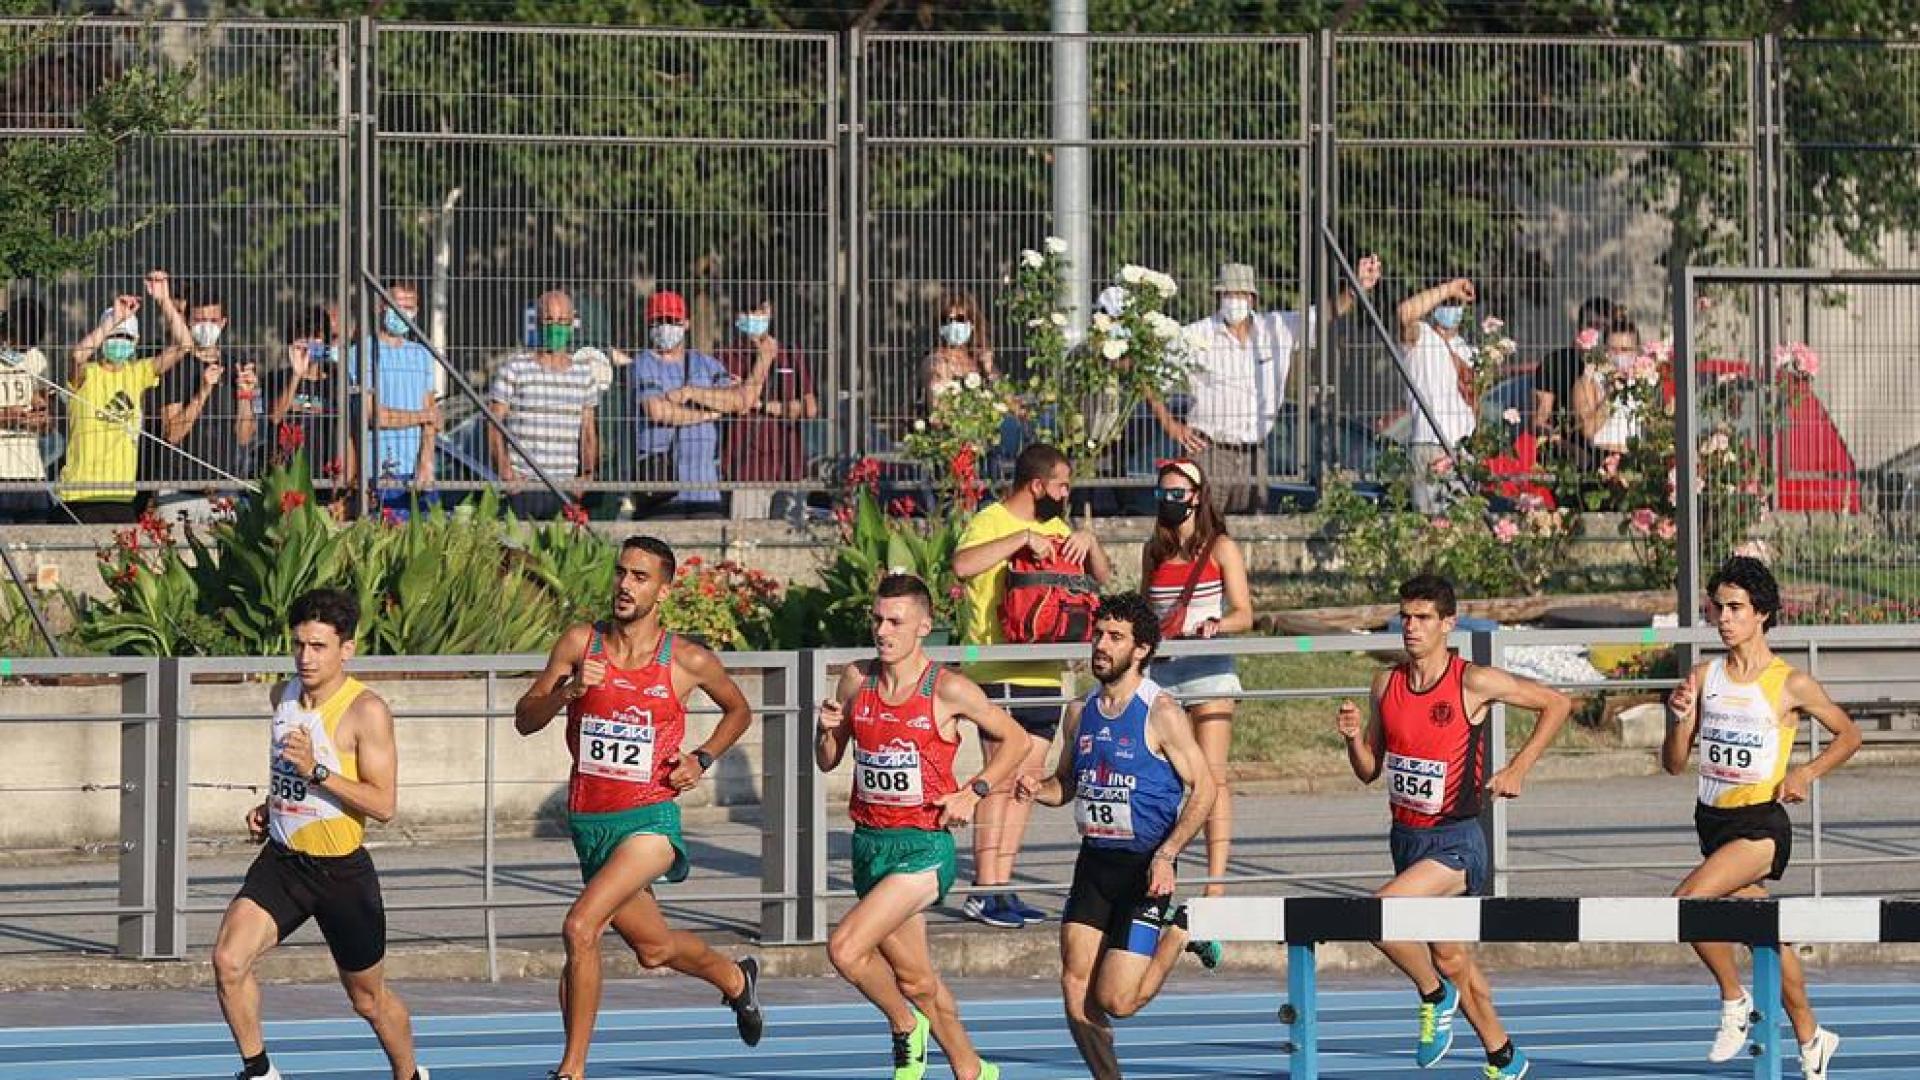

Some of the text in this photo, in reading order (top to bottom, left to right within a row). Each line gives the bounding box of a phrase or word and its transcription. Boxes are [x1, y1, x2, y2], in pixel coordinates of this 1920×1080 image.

[590, 740, 640, 765] 812
[1709, 744, 1752, 768] 619
[271, 776, 307, 801] 569
[864, 770, 909, 791] 808
[1394, 774, 1433, 799] 854
[1087, 804, 1114, 824] 18
